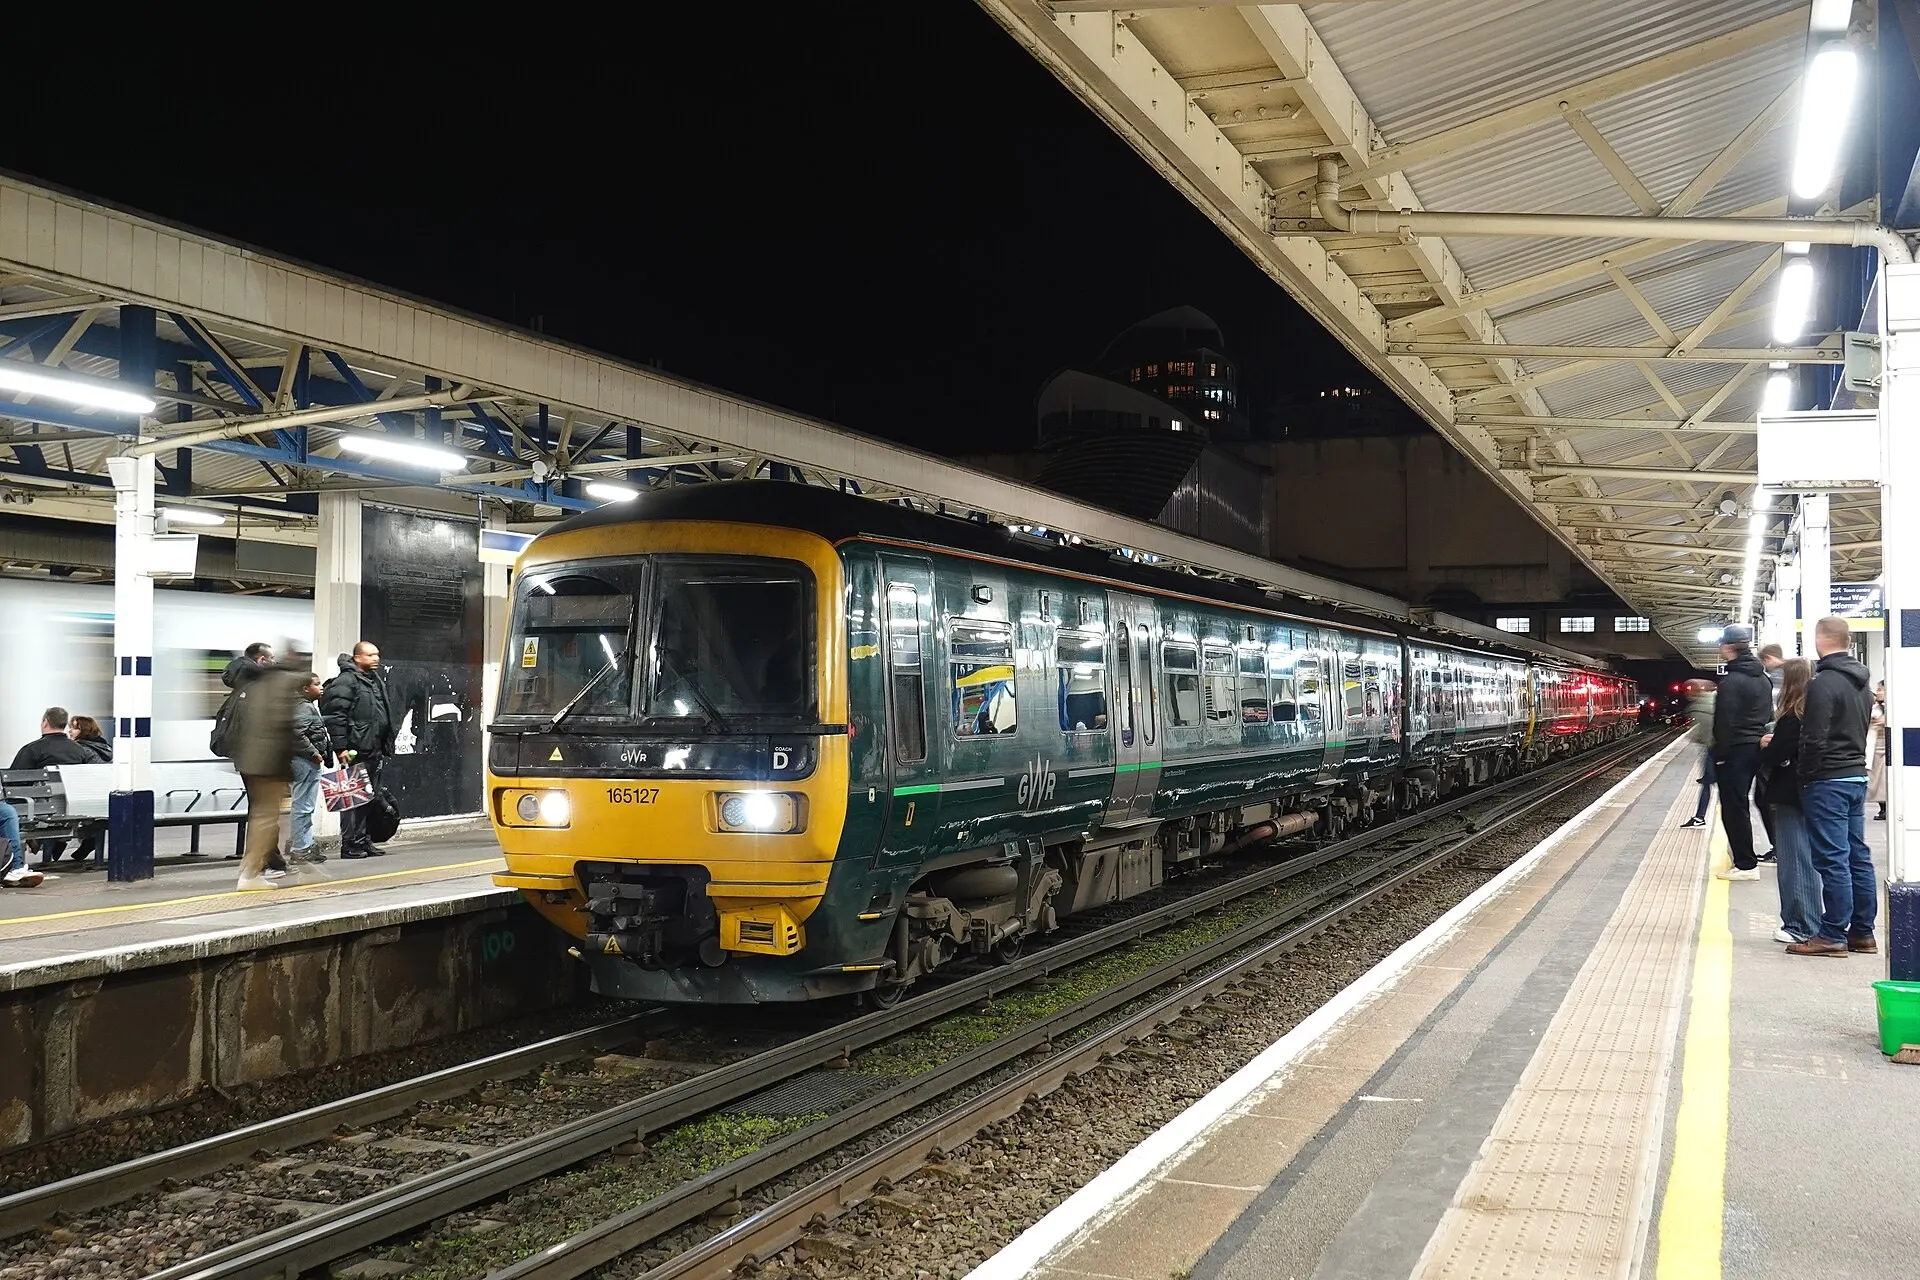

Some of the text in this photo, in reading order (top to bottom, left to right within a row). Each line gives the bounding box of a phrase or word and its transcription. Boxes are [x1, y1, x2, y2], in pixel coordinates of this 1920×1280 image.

[620, 747, 647, 764] GWR
[773, 752, 789, 770] D
[1018, 751, 1056, 811] GWR
[606, 787, 660, 804] 165127
